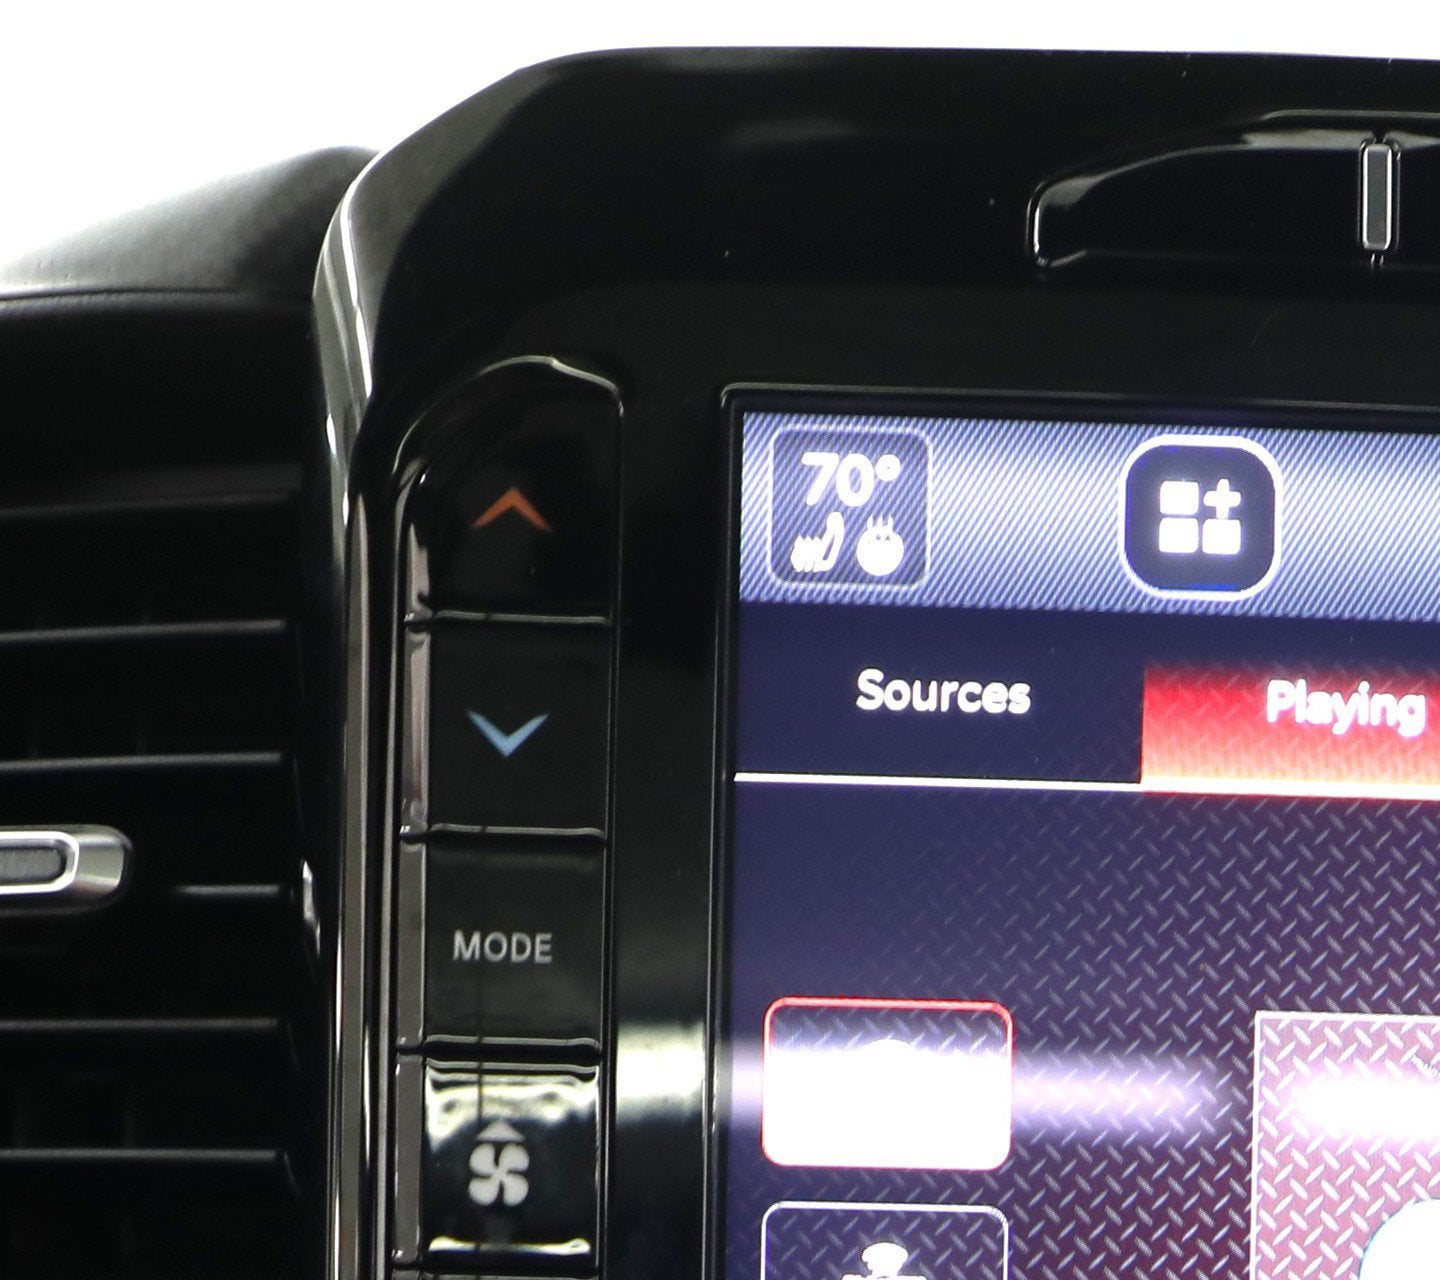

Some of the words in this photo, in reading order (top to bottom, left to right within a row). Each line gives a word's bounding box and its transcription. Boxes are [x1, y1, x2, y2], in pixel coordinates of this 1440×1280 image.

[801, 452, 901, 507] 70°
[855, 668, 1033, 716] Sources
[1265, 679, 1427, 738] Playing
[453, 931, 553, 964] MODE
